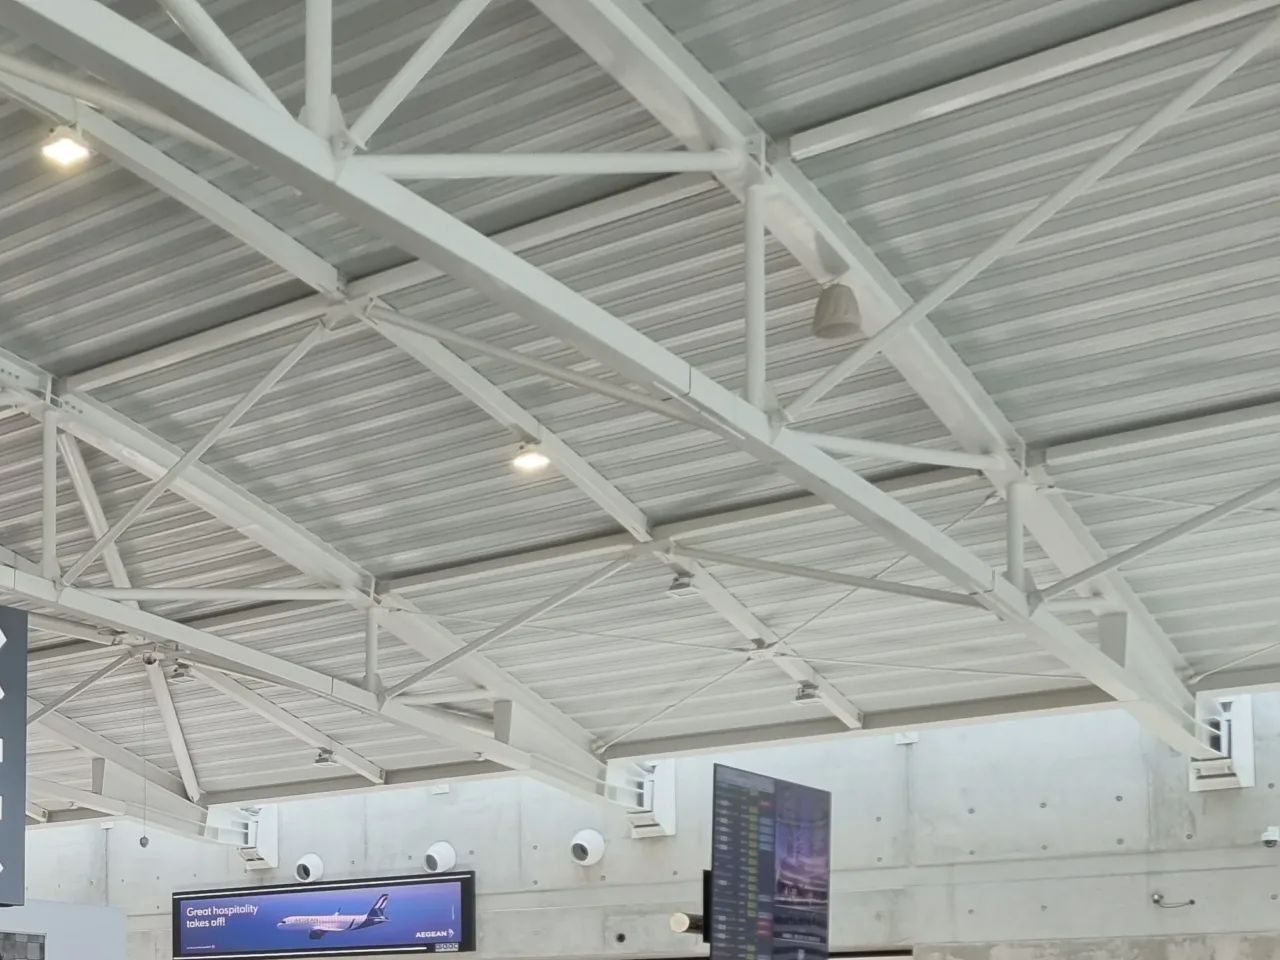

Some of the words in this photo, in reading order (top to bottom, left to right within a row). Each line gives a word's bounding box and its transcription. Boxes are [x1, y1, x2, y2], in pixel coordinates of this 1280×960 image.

[186, 905, 212, 917] Great
[213, 904, 259, 917] hospitality
[186, 918, 212, 928] takes
[214, 916, 226, 927] off!
